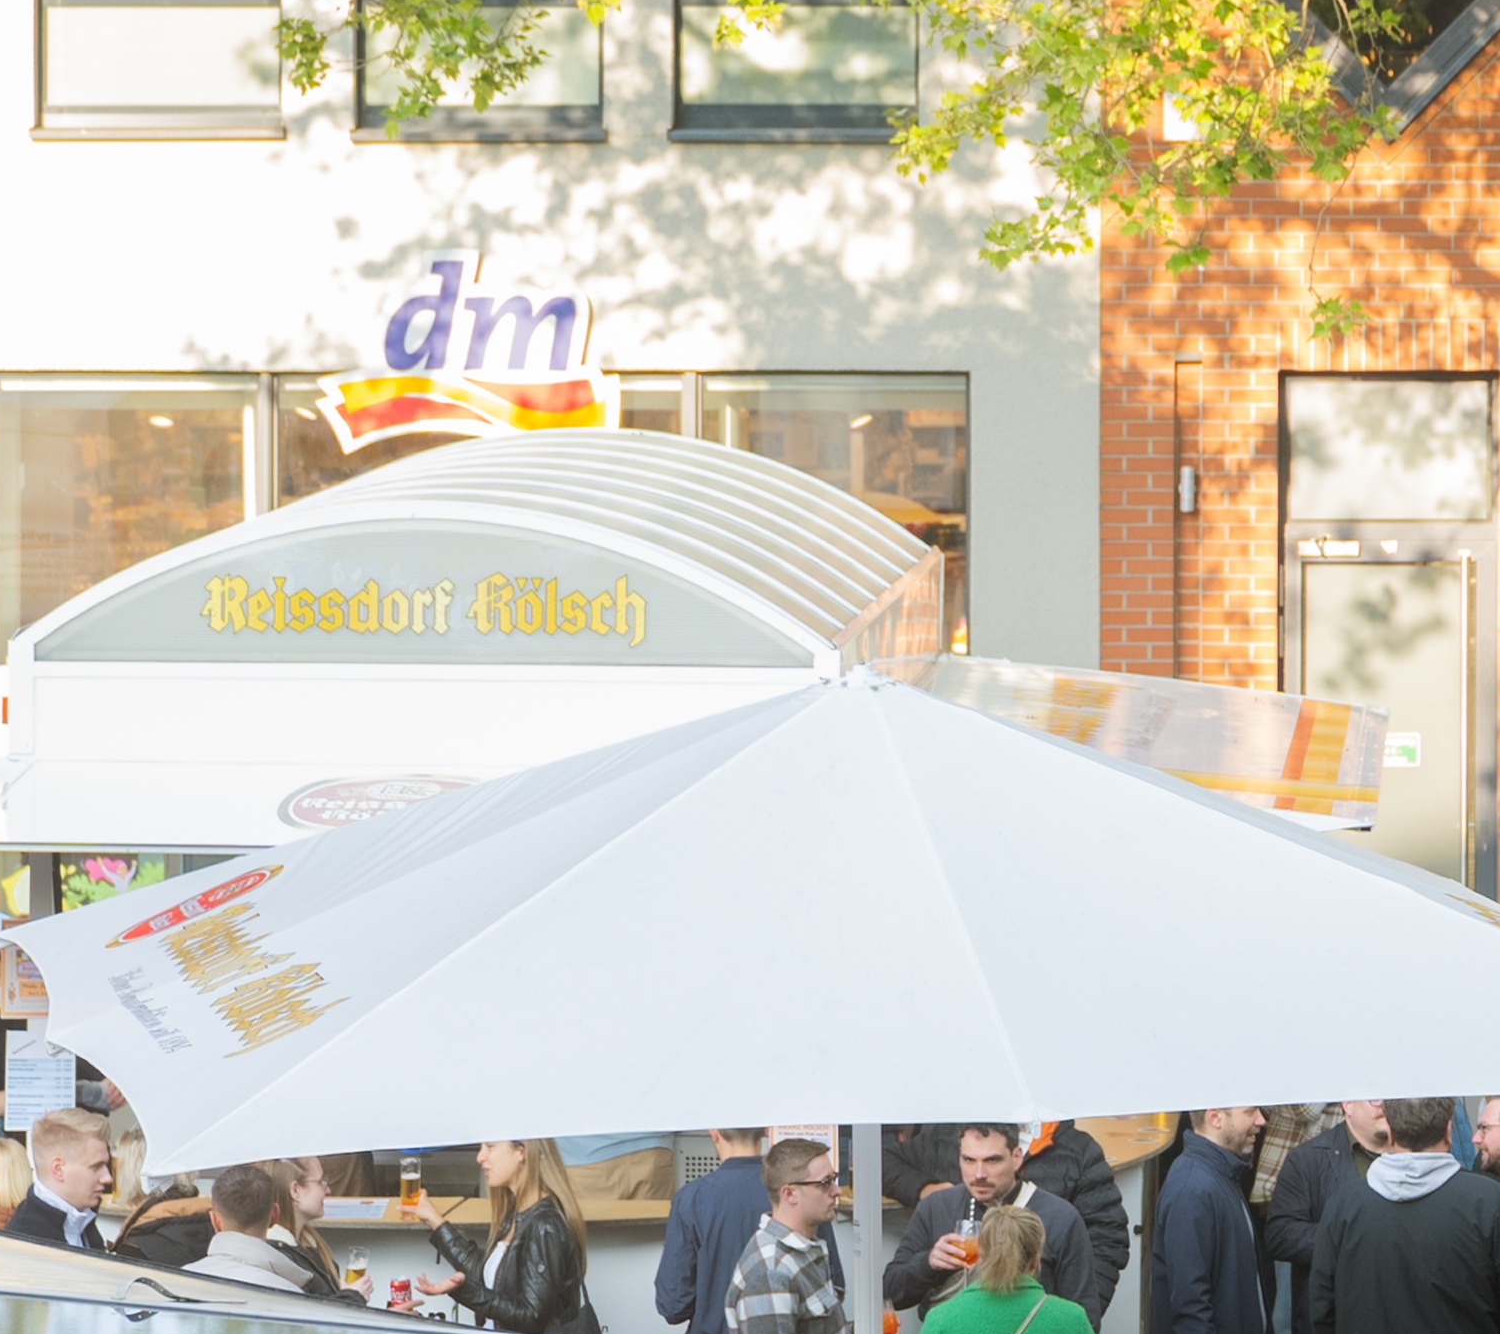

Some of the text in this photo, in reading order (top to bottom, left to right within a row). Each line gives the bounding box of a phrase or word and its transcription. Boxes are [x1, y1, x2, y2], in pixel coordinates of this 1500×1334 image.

[385, 260, 577, 371] dm
[200, 571, 648, 648] Reissdorf Kölsch
[300, 797, 409, 810] Reiss
